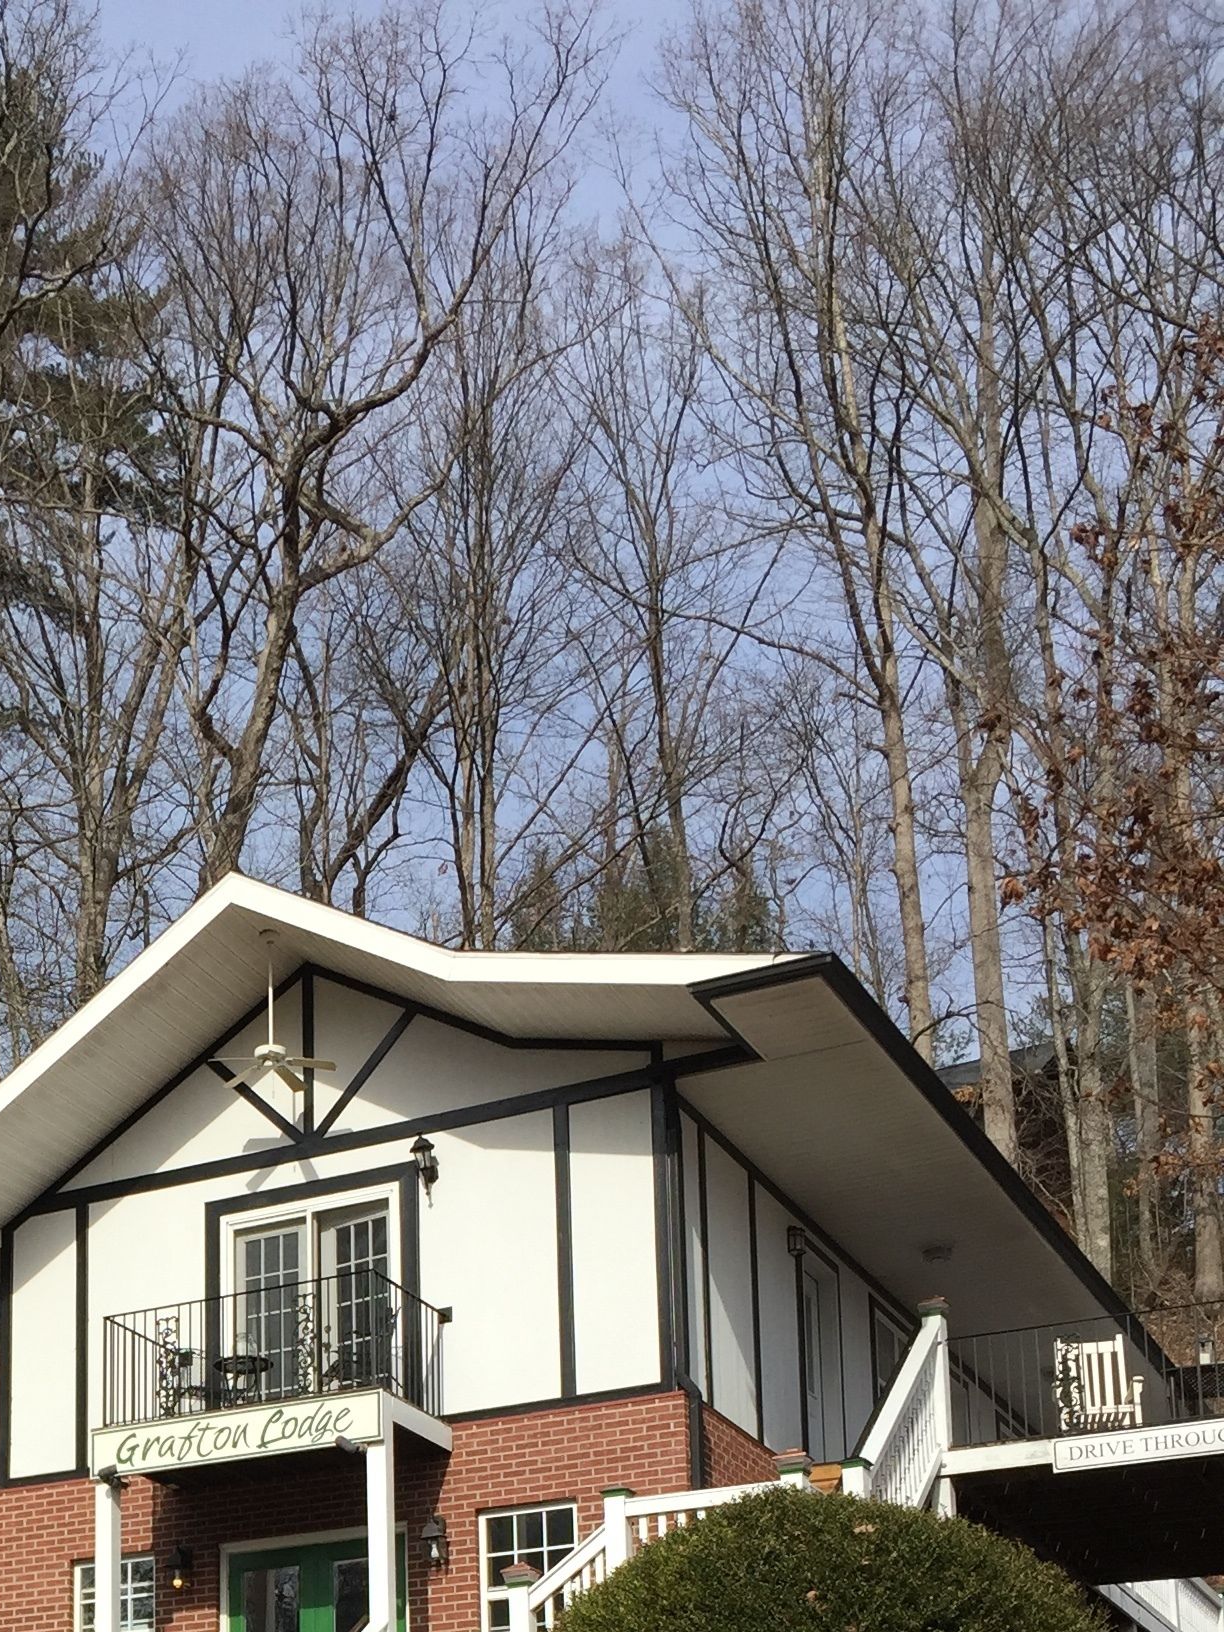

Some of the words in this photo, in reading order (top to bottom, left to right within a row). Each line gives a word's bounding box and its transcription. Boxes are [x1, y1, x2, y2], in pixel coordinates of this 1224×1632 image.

[116, 1420, 249, 1467] Grafton
[256, 1402, 353, 1449] Lodge
[1068, 1439, 1134, 1462] DRIVE
